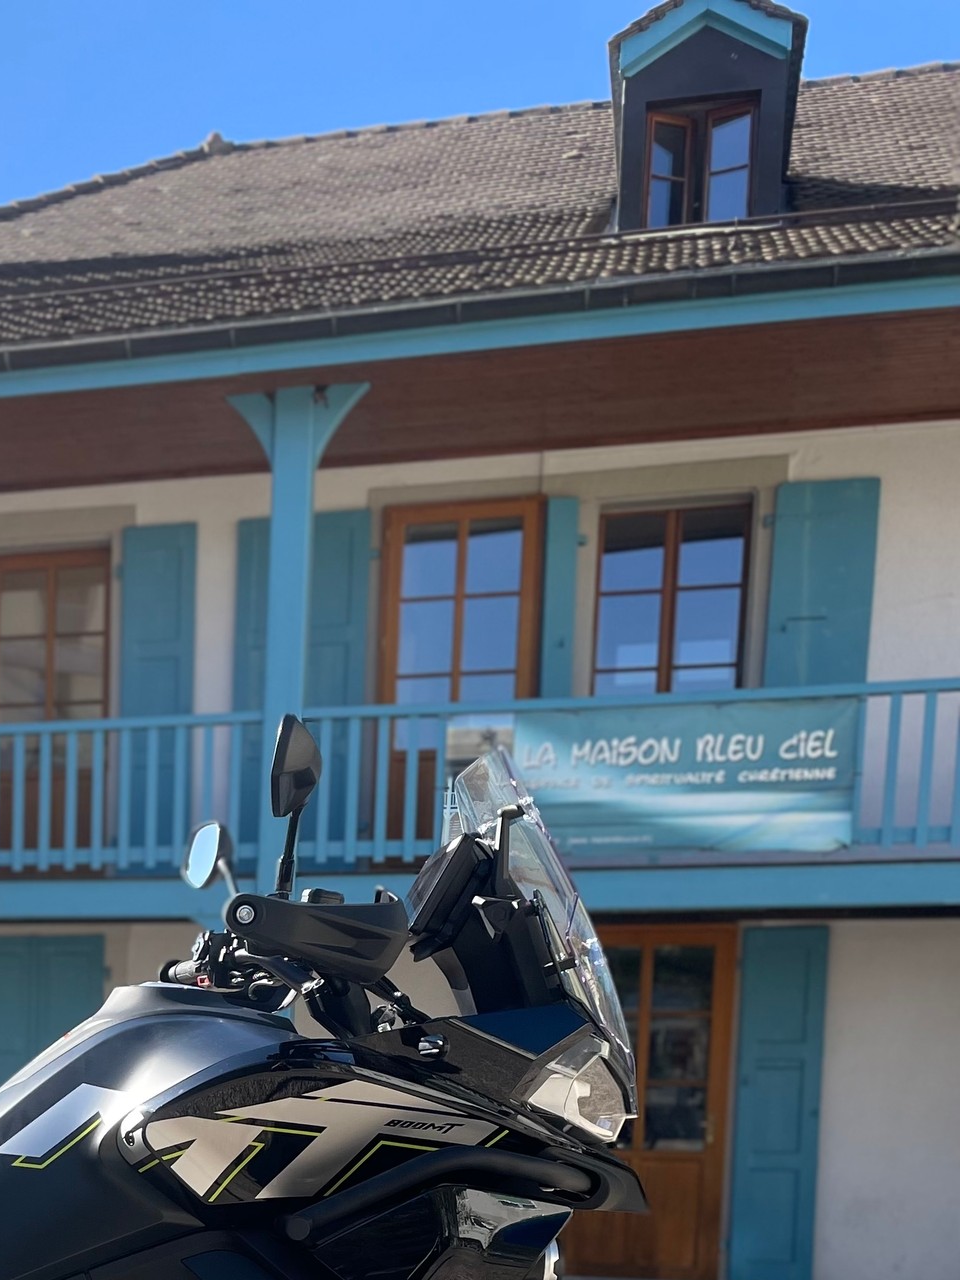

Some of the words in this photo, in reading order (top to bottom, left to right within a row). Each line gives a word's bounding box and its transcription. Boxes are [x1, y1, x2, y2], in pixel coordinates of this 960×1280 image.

[523, 741, 556, 769] LA
[572, 736, 681, 767] MAISON
[695, 733, 765, 762] BLEU
[778, 729, 838, 759] CIEL
[383, 1119, 466, 1134] 800MT
